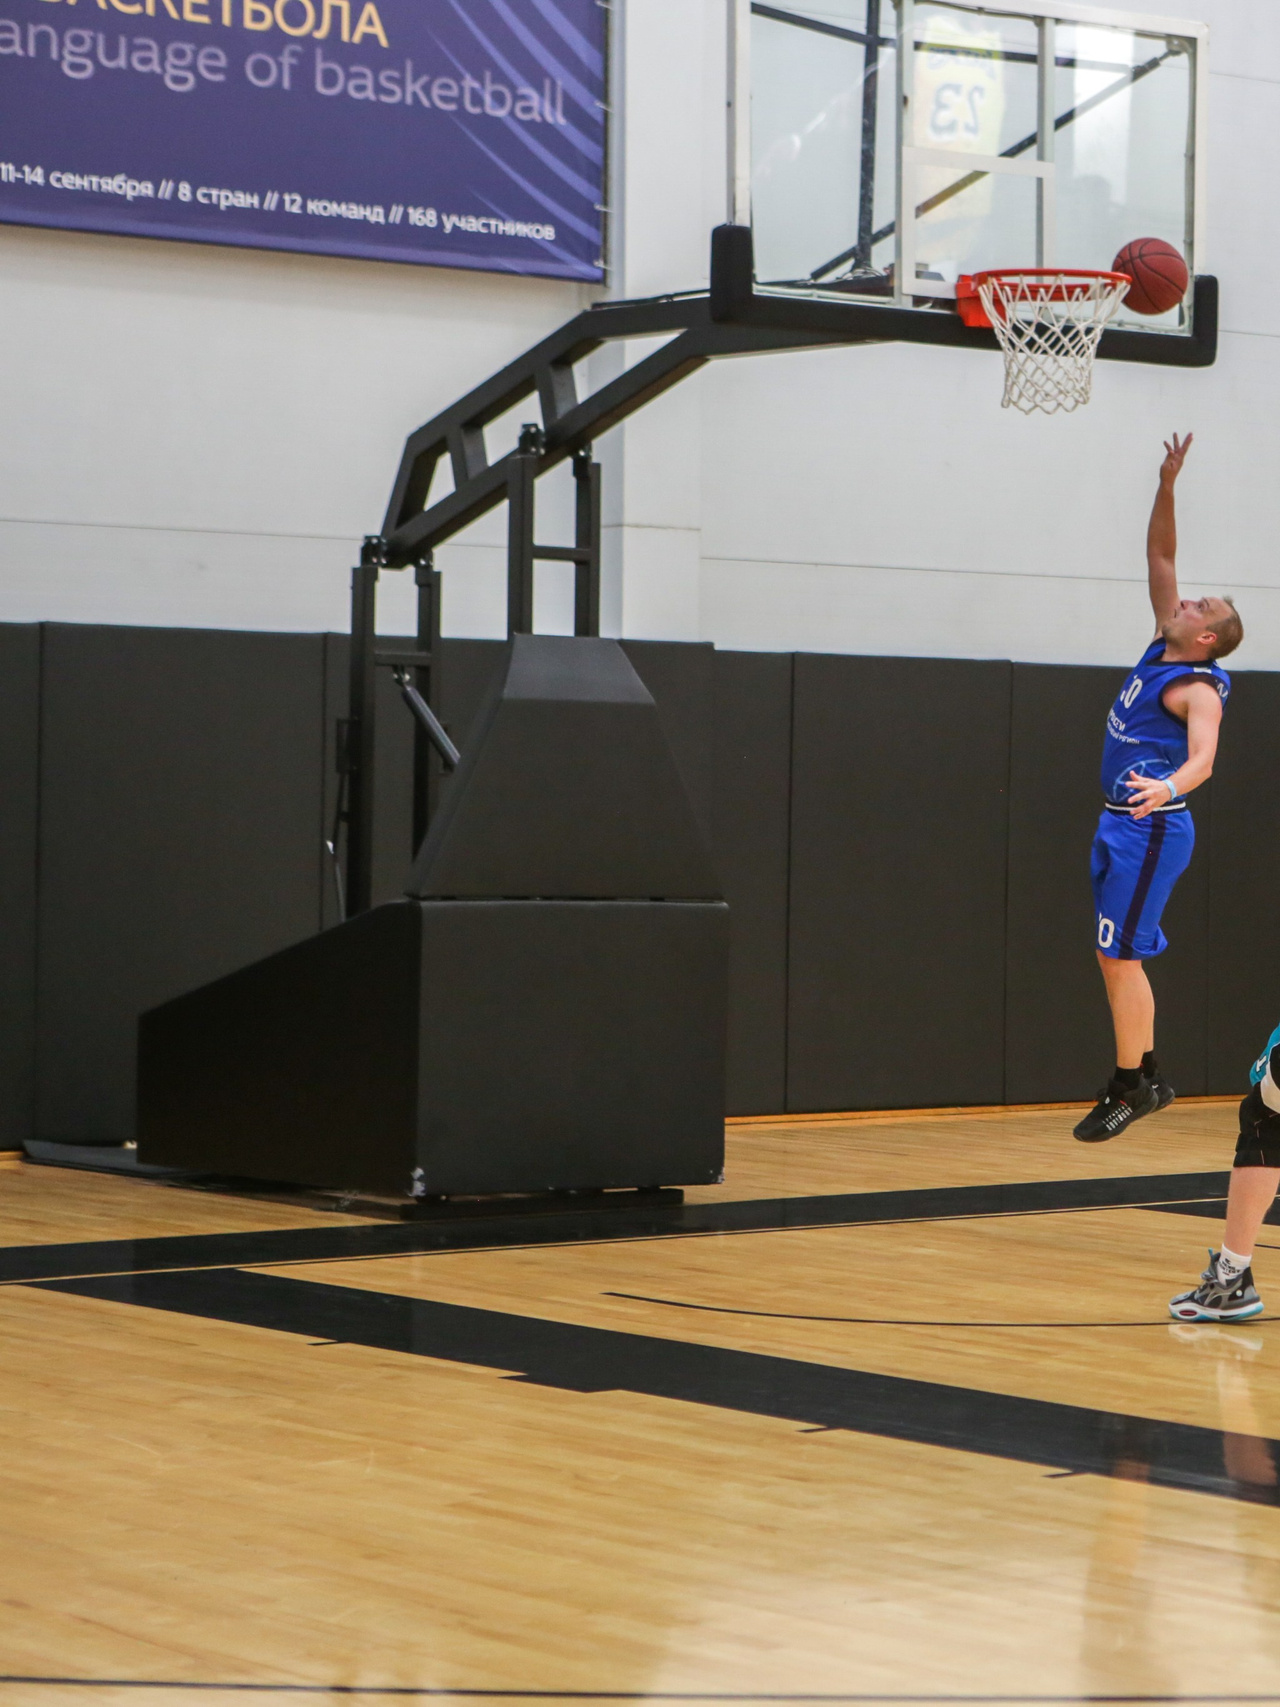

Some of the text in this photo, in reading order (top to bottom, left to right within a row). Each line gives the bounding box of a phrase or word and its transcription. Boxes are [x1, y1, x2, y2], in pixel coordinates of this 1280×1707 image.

[37, 0, 389, 48] ЕТБОЛА
[0, 19, 567, 126] anguage of basketball
[0, 161, 45, 187] 11-14
[50, 171, 155, 202] сентября
[178, 180, 192, 202] 8
[196, 186, 259, 211] стран
[283, 190, 302, 214] 12
[307, 198, 386, 225] команд
[406, 206, 437, 228] 168
[441, 213, 556, 241] участников
